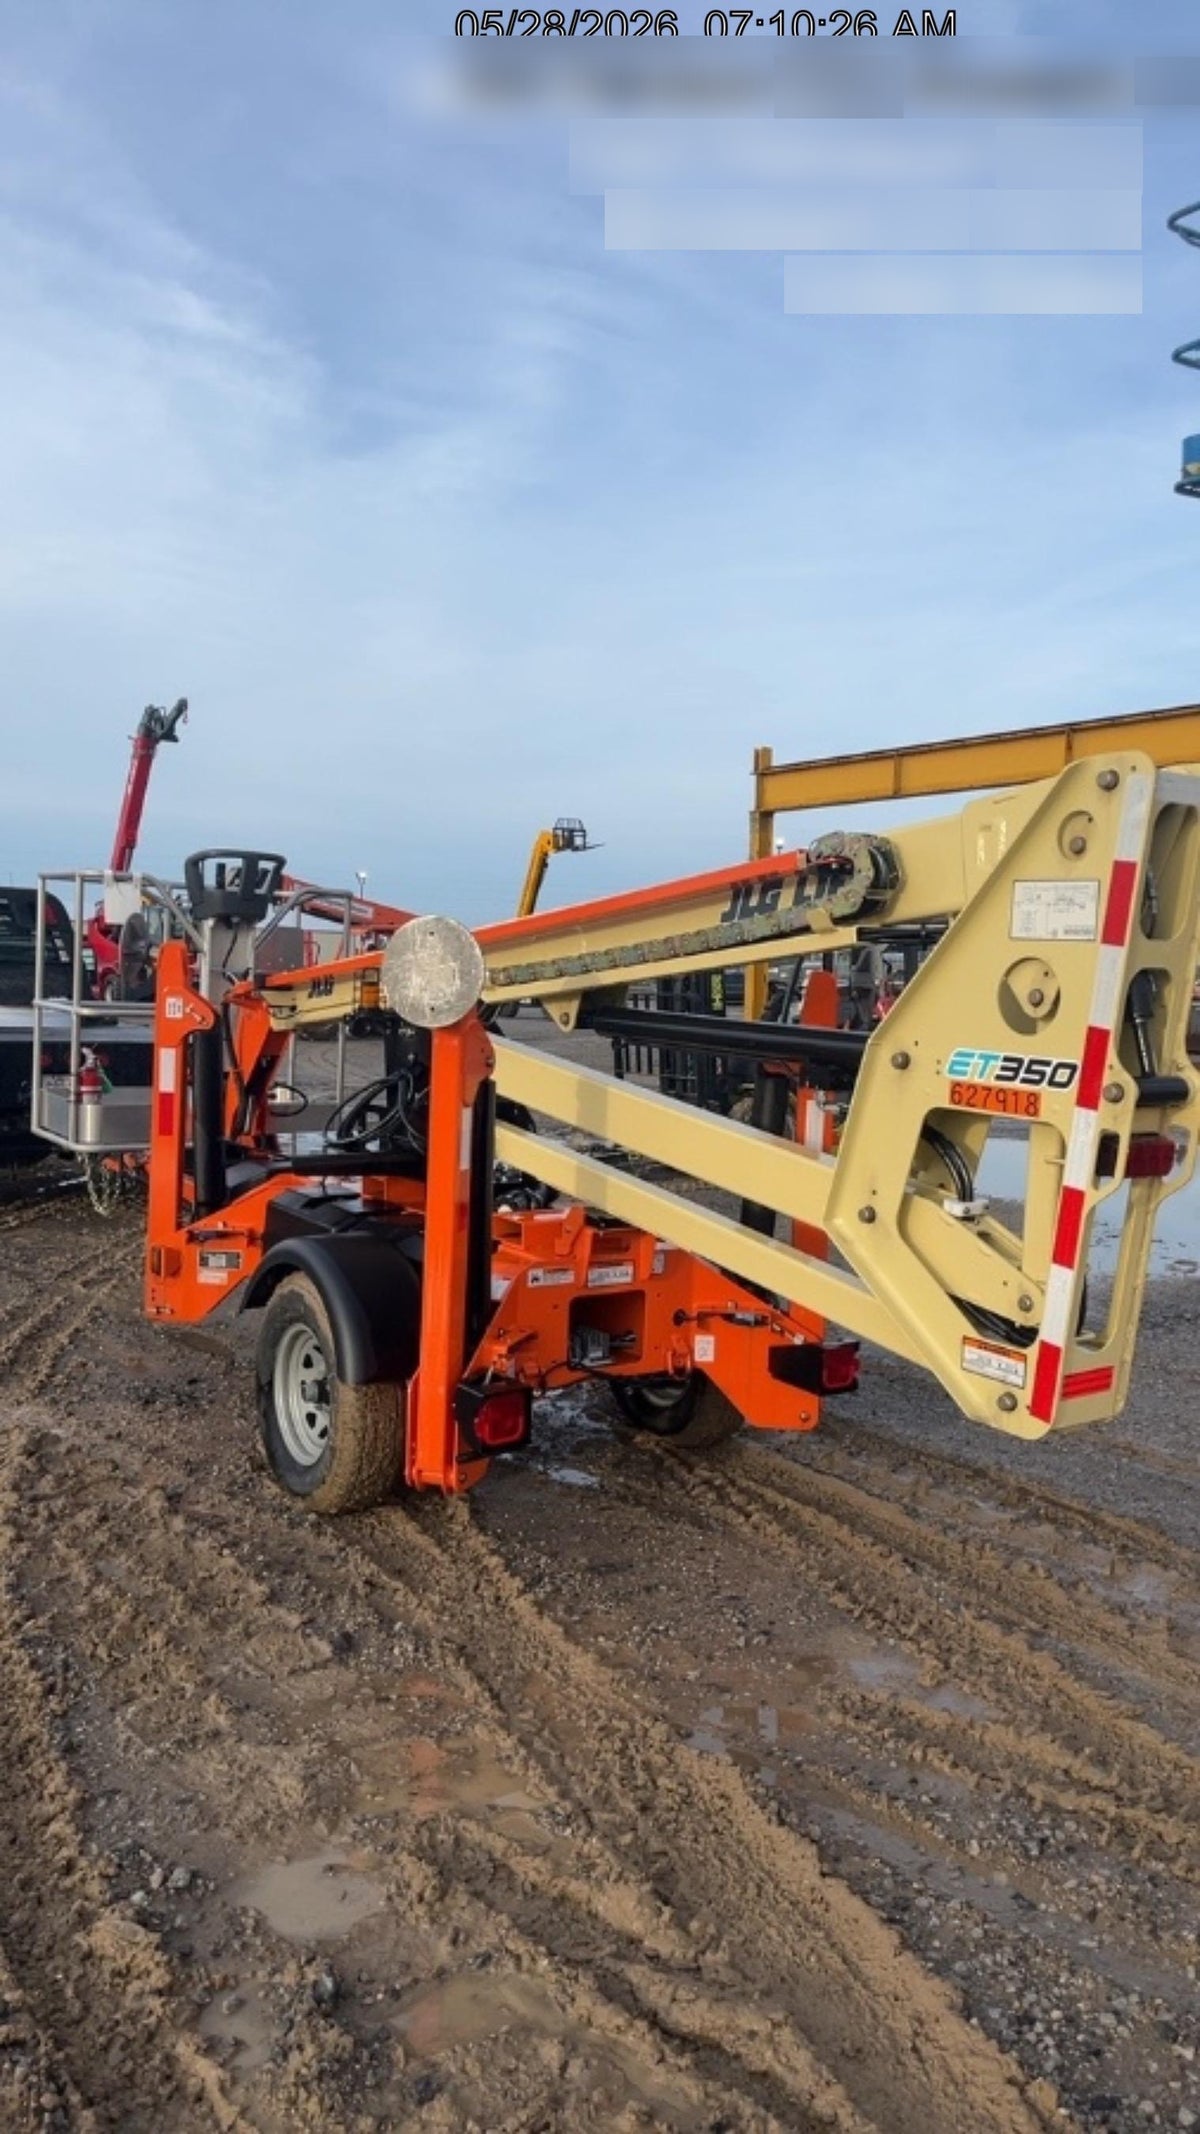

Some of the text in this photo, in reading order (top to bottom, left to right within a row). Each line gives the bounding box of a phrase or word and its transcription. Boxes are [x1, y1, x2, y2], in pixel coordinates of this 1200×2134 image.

[720, 873, 784, 922] JLG
[947, 1050, 1078, 1089] ET350
[950, 1083, 1039, 1117] 627918
